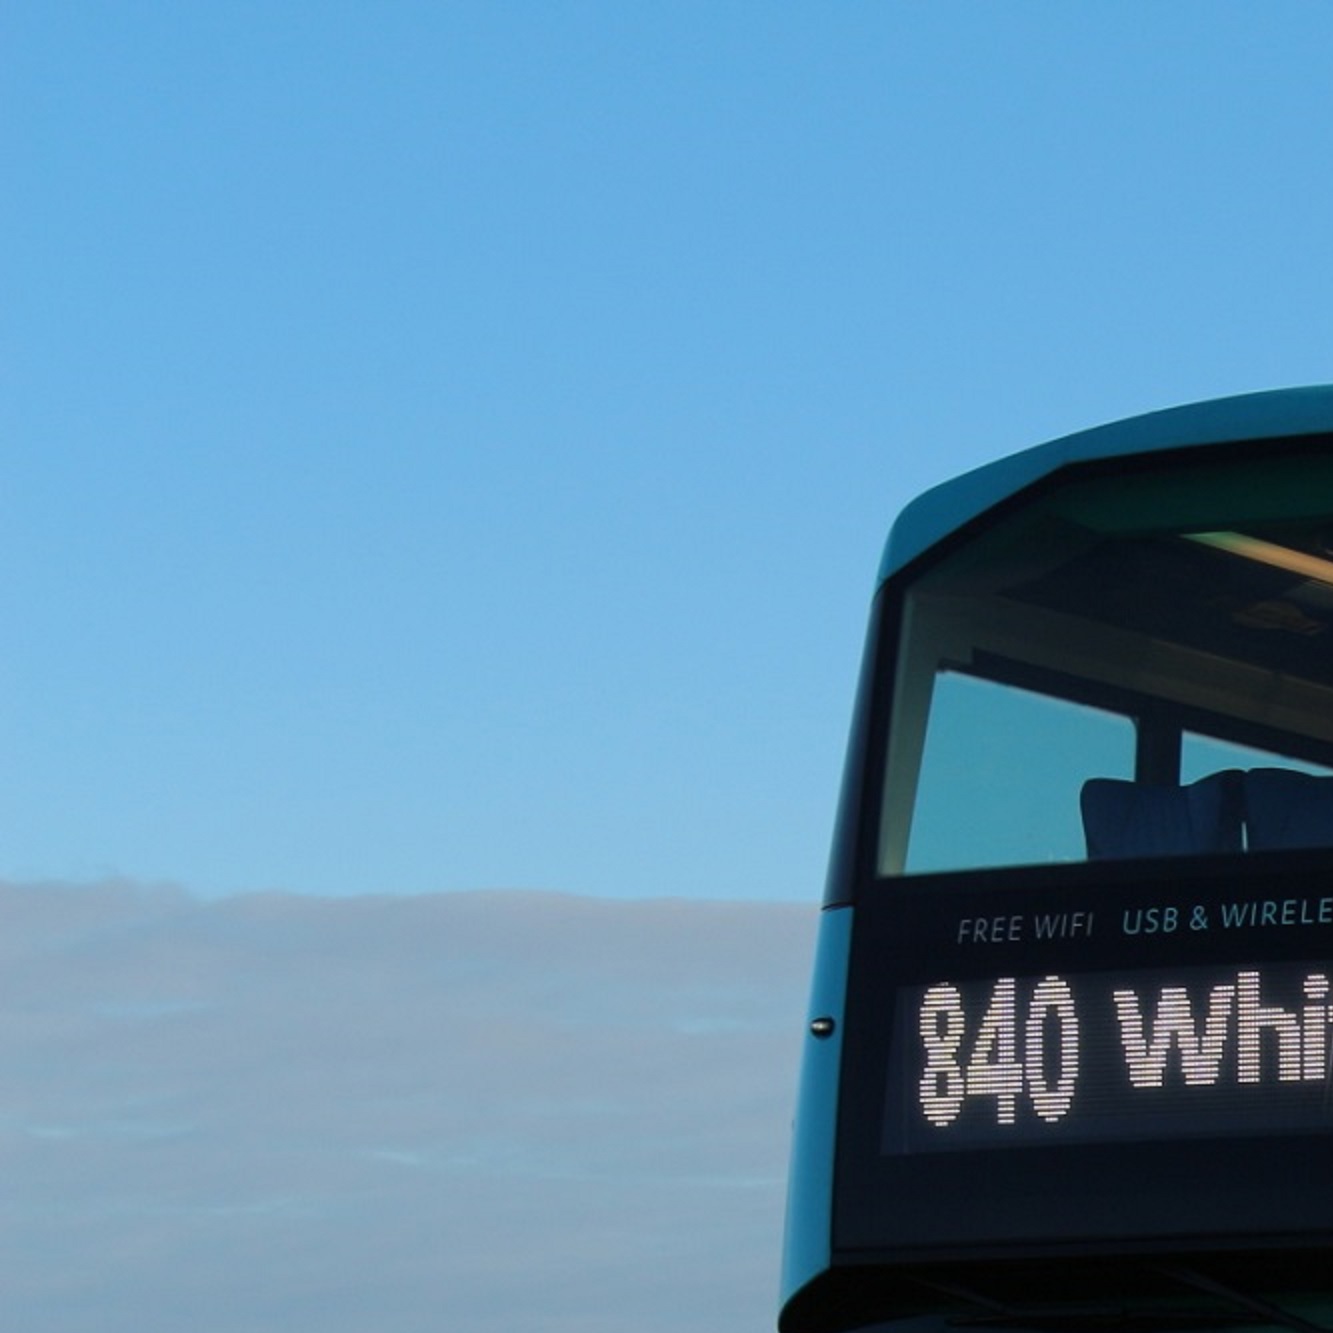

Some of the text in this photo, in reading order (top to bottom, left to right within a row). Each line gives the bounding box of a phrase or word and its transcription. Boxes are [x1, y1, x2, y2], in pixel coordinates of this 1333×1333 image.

[957, 911, 1094, 944] FREE WIFI
[1122, 907, 1178, 935] USB
[1188, 905, 1208, 931] &
[919, 976, 1079, 1126] 840
